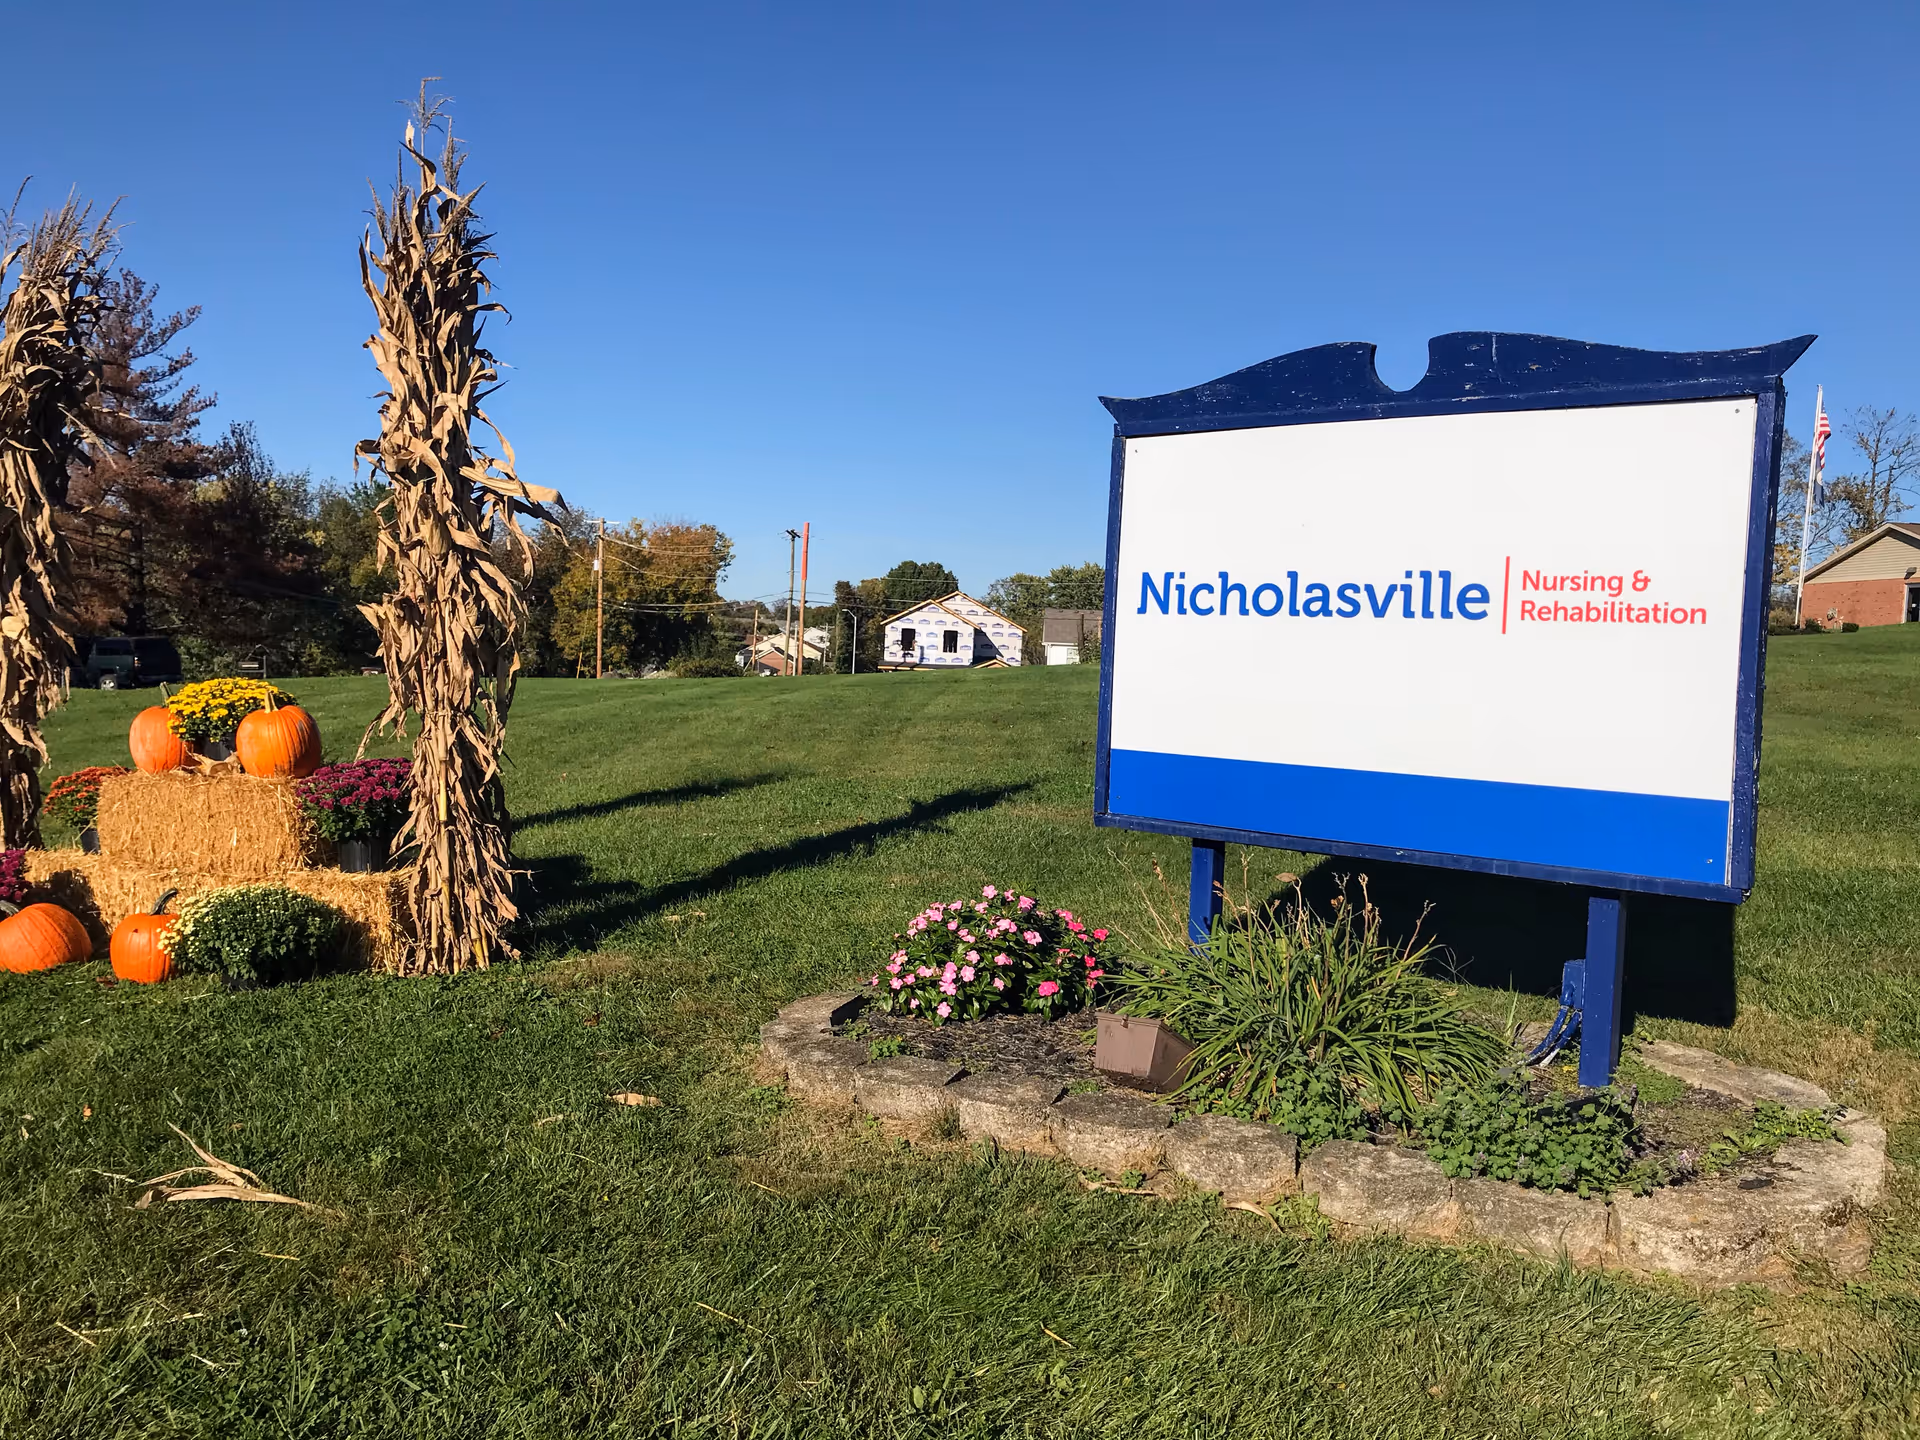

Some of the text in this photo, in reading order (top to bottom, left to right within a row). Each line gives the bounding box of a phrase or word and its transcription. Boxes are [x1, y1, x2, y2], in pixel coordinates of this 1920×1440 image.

[1136, 569, 1491, 621] Nicholasville
[1521, 569, 1652, 598] Nursing &
[1520, 599, 1707, 625] Rehabilitation
